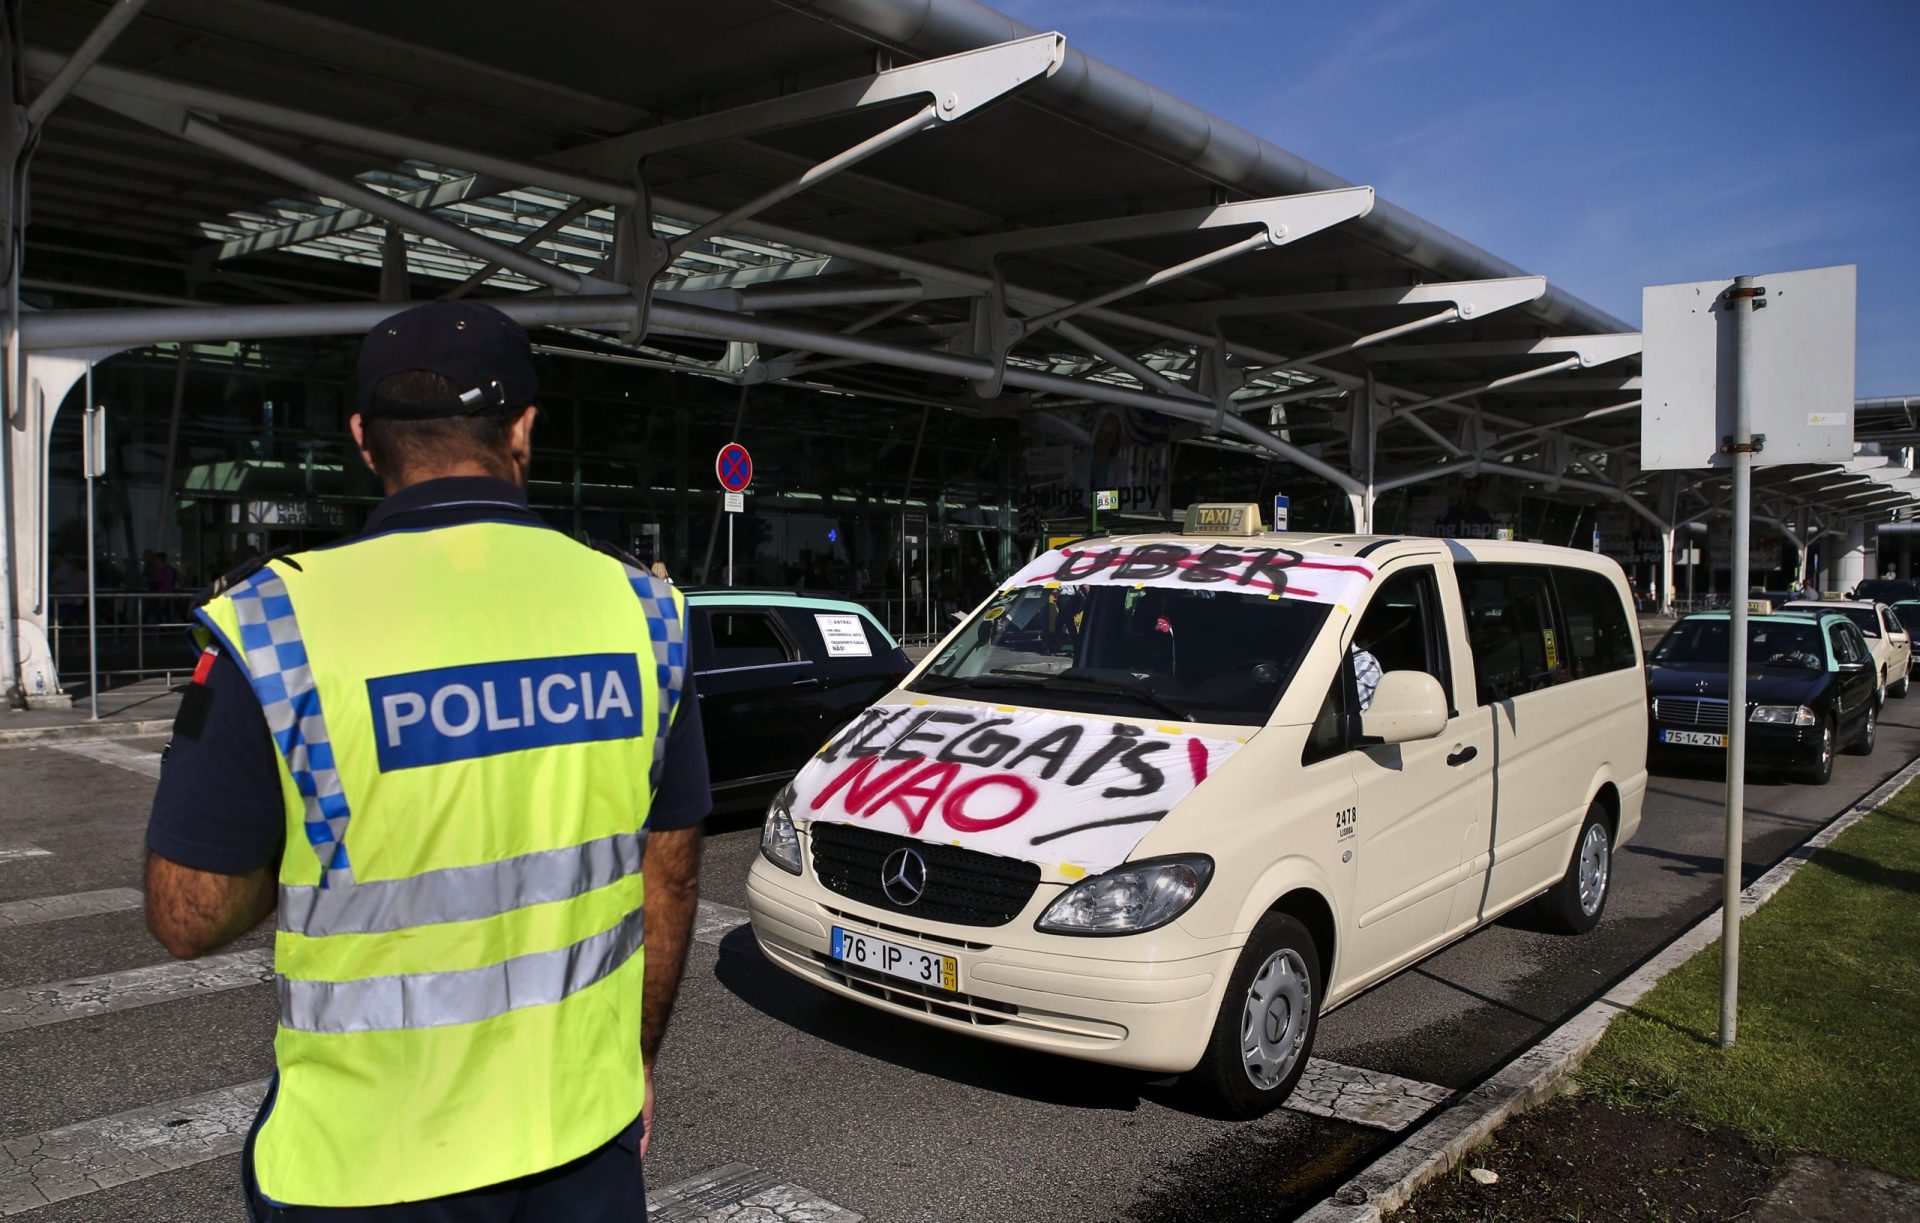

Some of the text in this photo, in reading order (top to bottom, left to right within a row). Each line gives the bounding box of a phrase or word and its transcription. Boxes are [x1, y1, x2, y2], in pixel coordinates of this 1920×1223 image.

[277, 513, 344, 525] ARRLS
[1199, 509, 1229, 524] TAXI
[1053, 544, 1303, 596] UBER
[382, 671, 633, 747] POLICIA
[1336, 806, 1357, 828] 2478
[945, 961, 954, 971] 10
